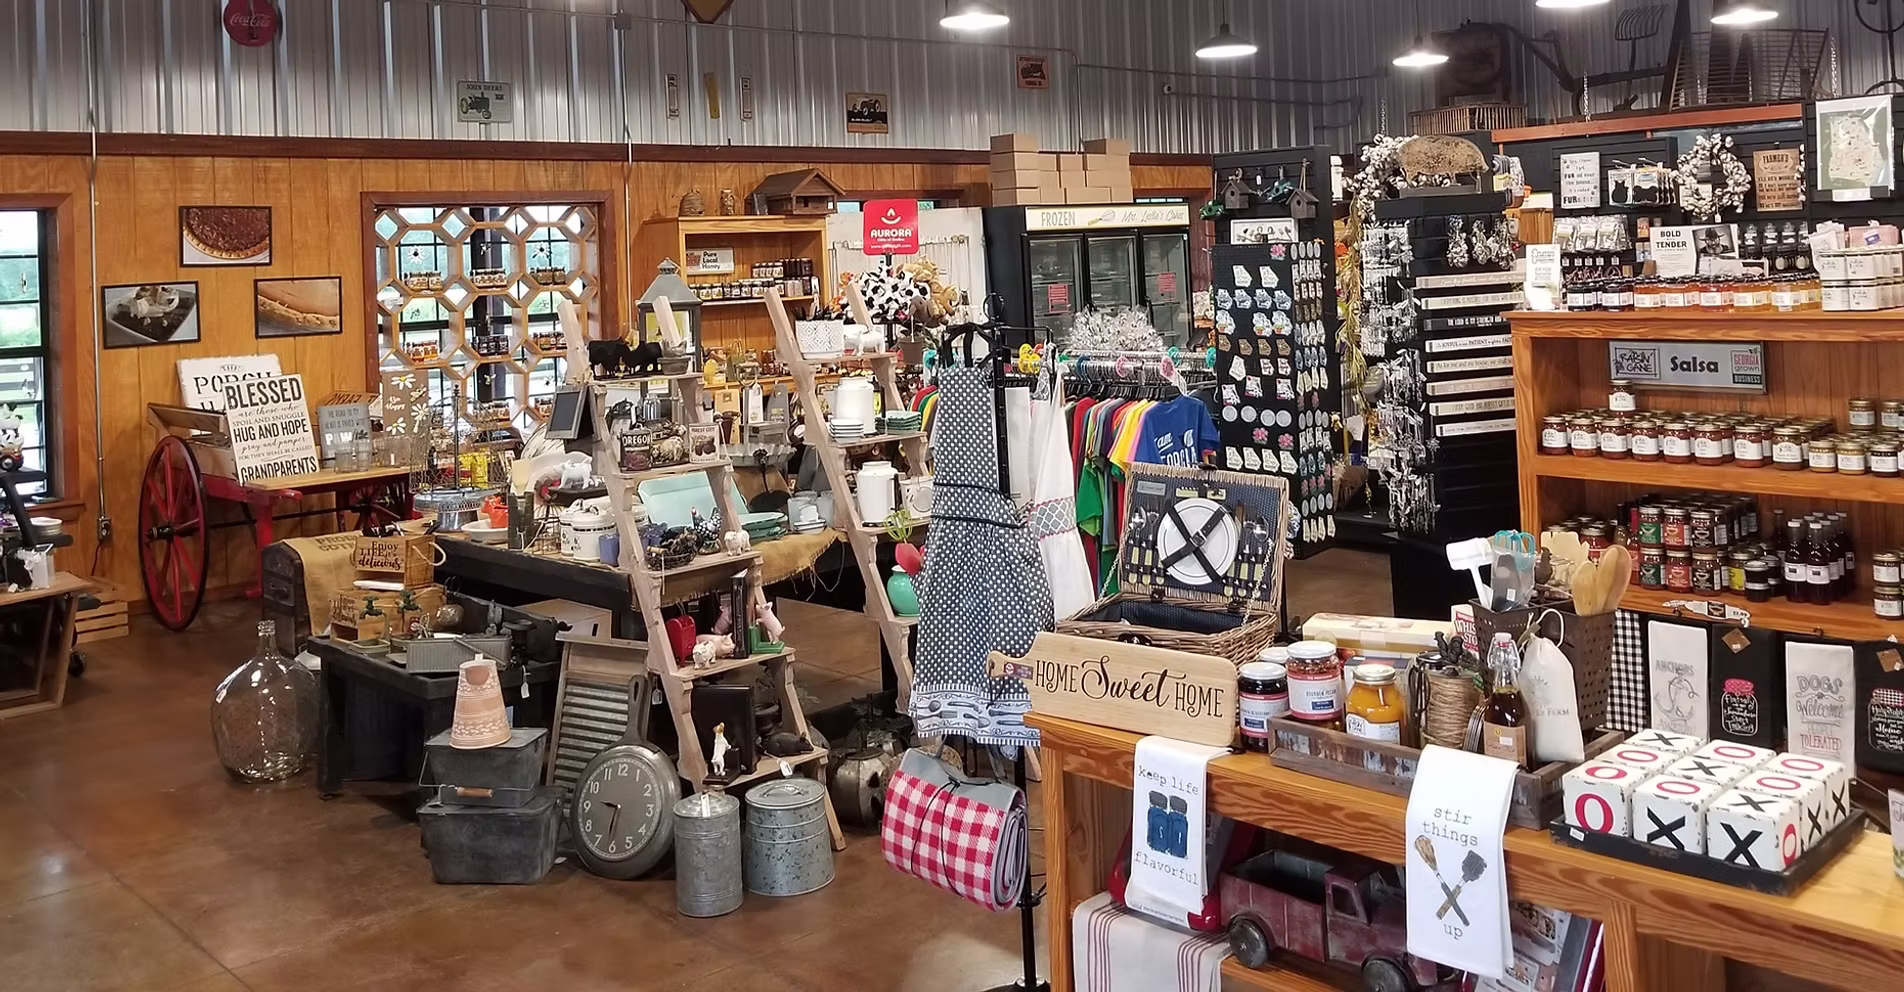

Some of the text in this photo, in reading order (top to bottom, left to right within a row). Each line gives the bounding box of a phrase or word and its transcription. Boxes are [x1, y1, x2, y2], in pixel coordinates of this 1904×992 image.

[1041, 211, 1075, 227] FROZEN
[870, 228, 912, 239] AURORA
[1660, 230, 1681, 238] BOLD
[1670, 355, 1719, 373] Salsa
[1734, 354, 1760, 366] GEORGIA
[1734, 375, 1761, 384] BUSINESS
[224, 377, 302, 410] BLESSED
[254, 416, 271, 424] AND
[272, 411, 304, 421] SNUGGLE
[256, 406, 278, 415] those
[233, 418, 309, 443] HUG AND HOPE
[241, 436, 306, 454] pray and pamper
[291, 445, 313, 453] CALLED
[240, 456, 317, 483] GRANDPARENTS
[360, 548, 385, 557] LIFE
[372, 541, 399, 553] Enjoy
[359, 555, 402, 570] delicious
[1035, 655, 1225, 717] HOME Sweet HOME
[1796, 675, 1843, 694] DOGS
[1796, 698, 1845, 719] Welcome
[1799, 733, 1842, 751] TOLERATED
[604, 768, 613, 781] 11
[618, 763, 629, 777] 12
[635, 769, 641, 782] 1
[589, 781, 600, 794] 10
[1138, 765, 1199, 796] keep life
[643, 784, 652, 797] 2
[583, 800, 592, 813] 9
[646, 804, 655, 817] 3
[1433, 807, 1472, 826] stir
[585, 819, 593, 832] 8
[638, 823, 647, 836] 4
[594, 834, 603, 847] 7
[1422, 820, 1479, 847] things
[608, 840, 616, 854] 6
[625, 836, 634, 850] 5
[1134, 850, 1199, 886] flavorful
[1443, 923, 1464, 941] up
